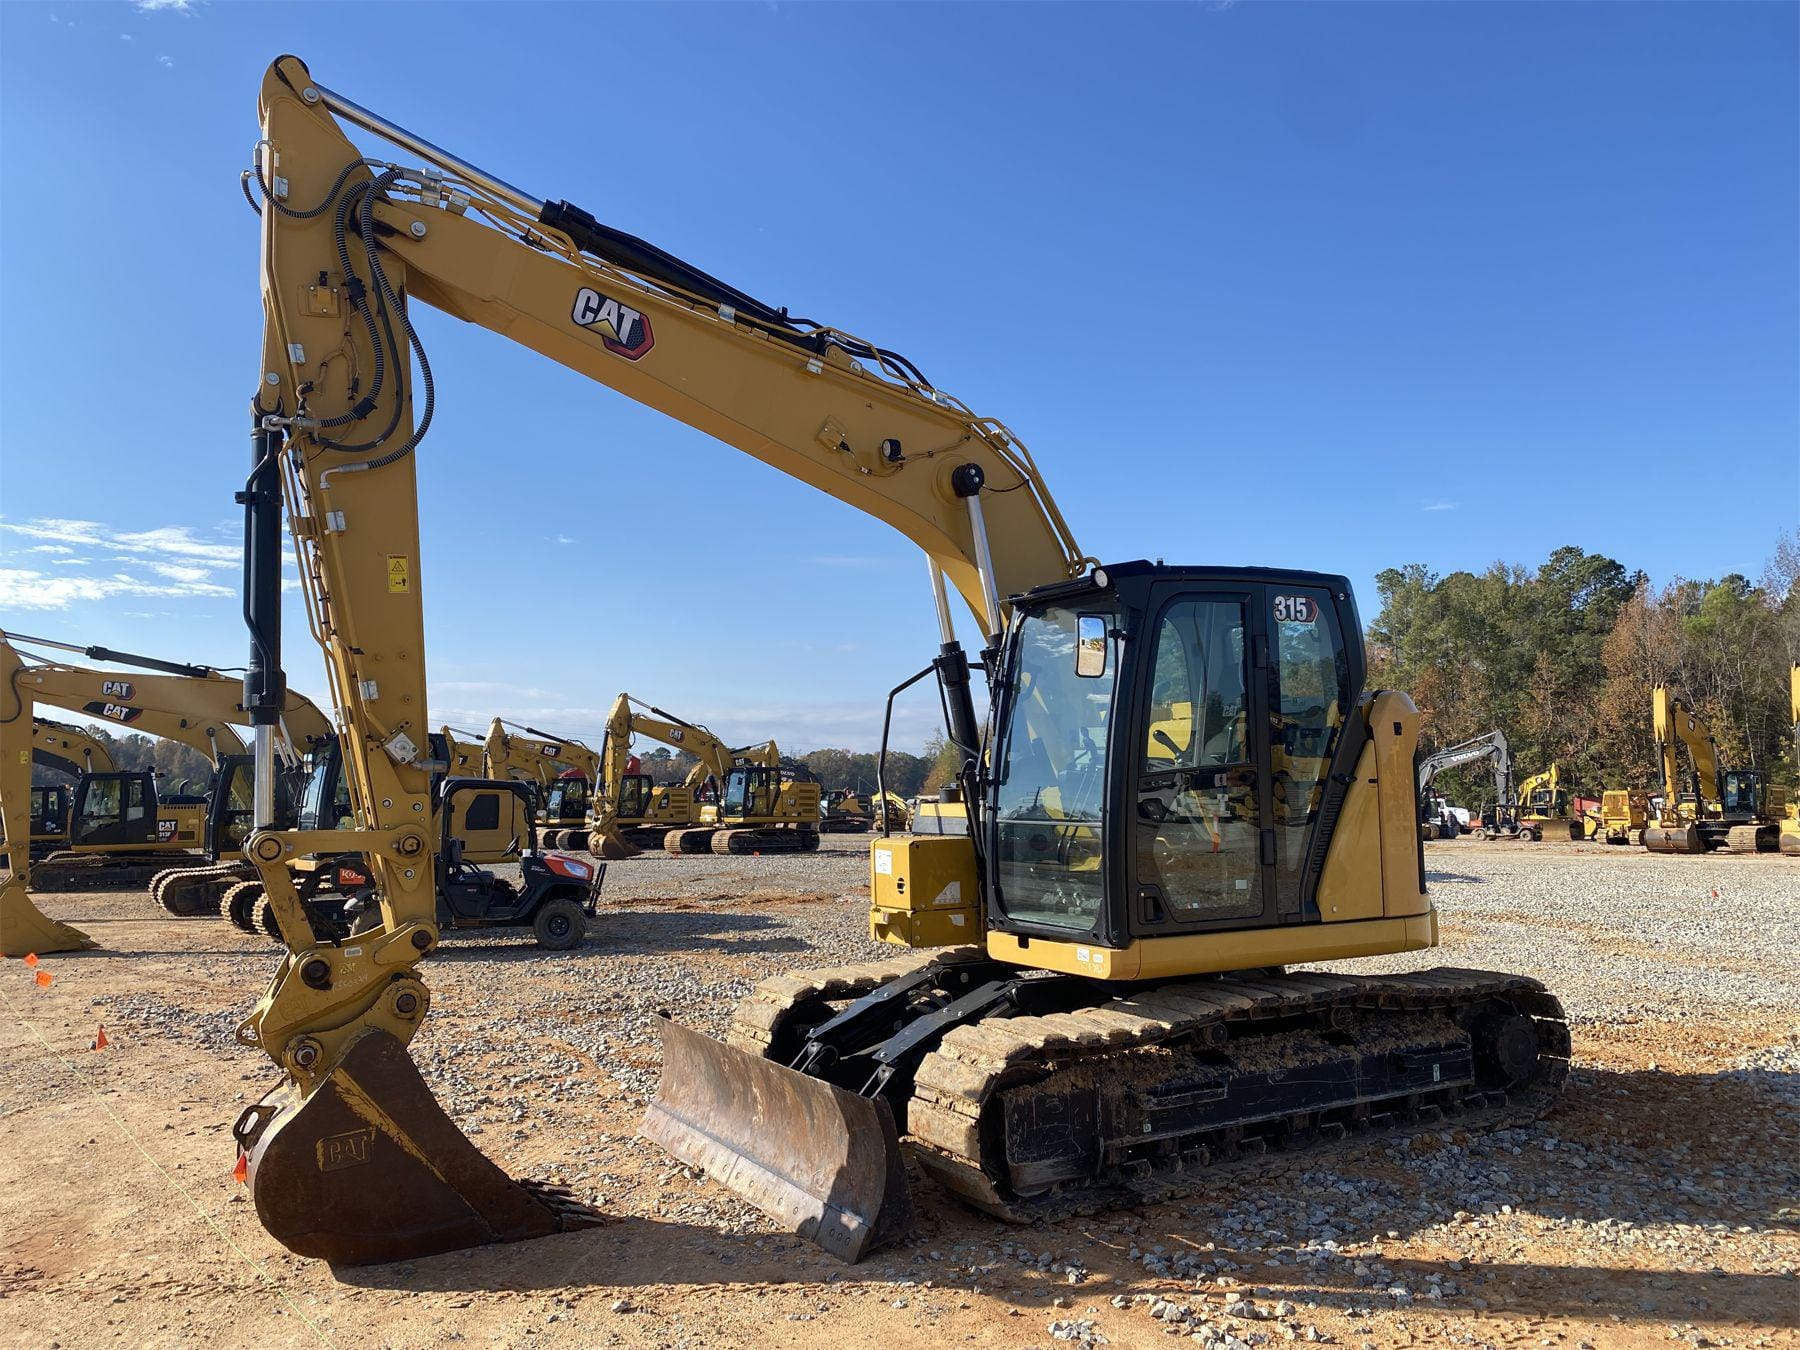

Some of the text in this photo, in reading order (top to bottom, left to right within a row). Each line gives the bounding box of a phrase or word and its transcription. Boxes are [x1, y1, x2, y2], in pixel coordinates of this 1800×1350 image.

[573, 288, 640, 344] CAT
[1274, 595, 1308, 621] 315
[102, 681, 130, 697] CAT
[103, 703, 129, 720] CAT
[670, 729, 682, 740] CAT
[544, 746, 557, 756] CAT
[1451, 751, 1480, 761] VOLVO
[735, 758, 744, 766] CAT
[159, 821, 176, 831] CAT
